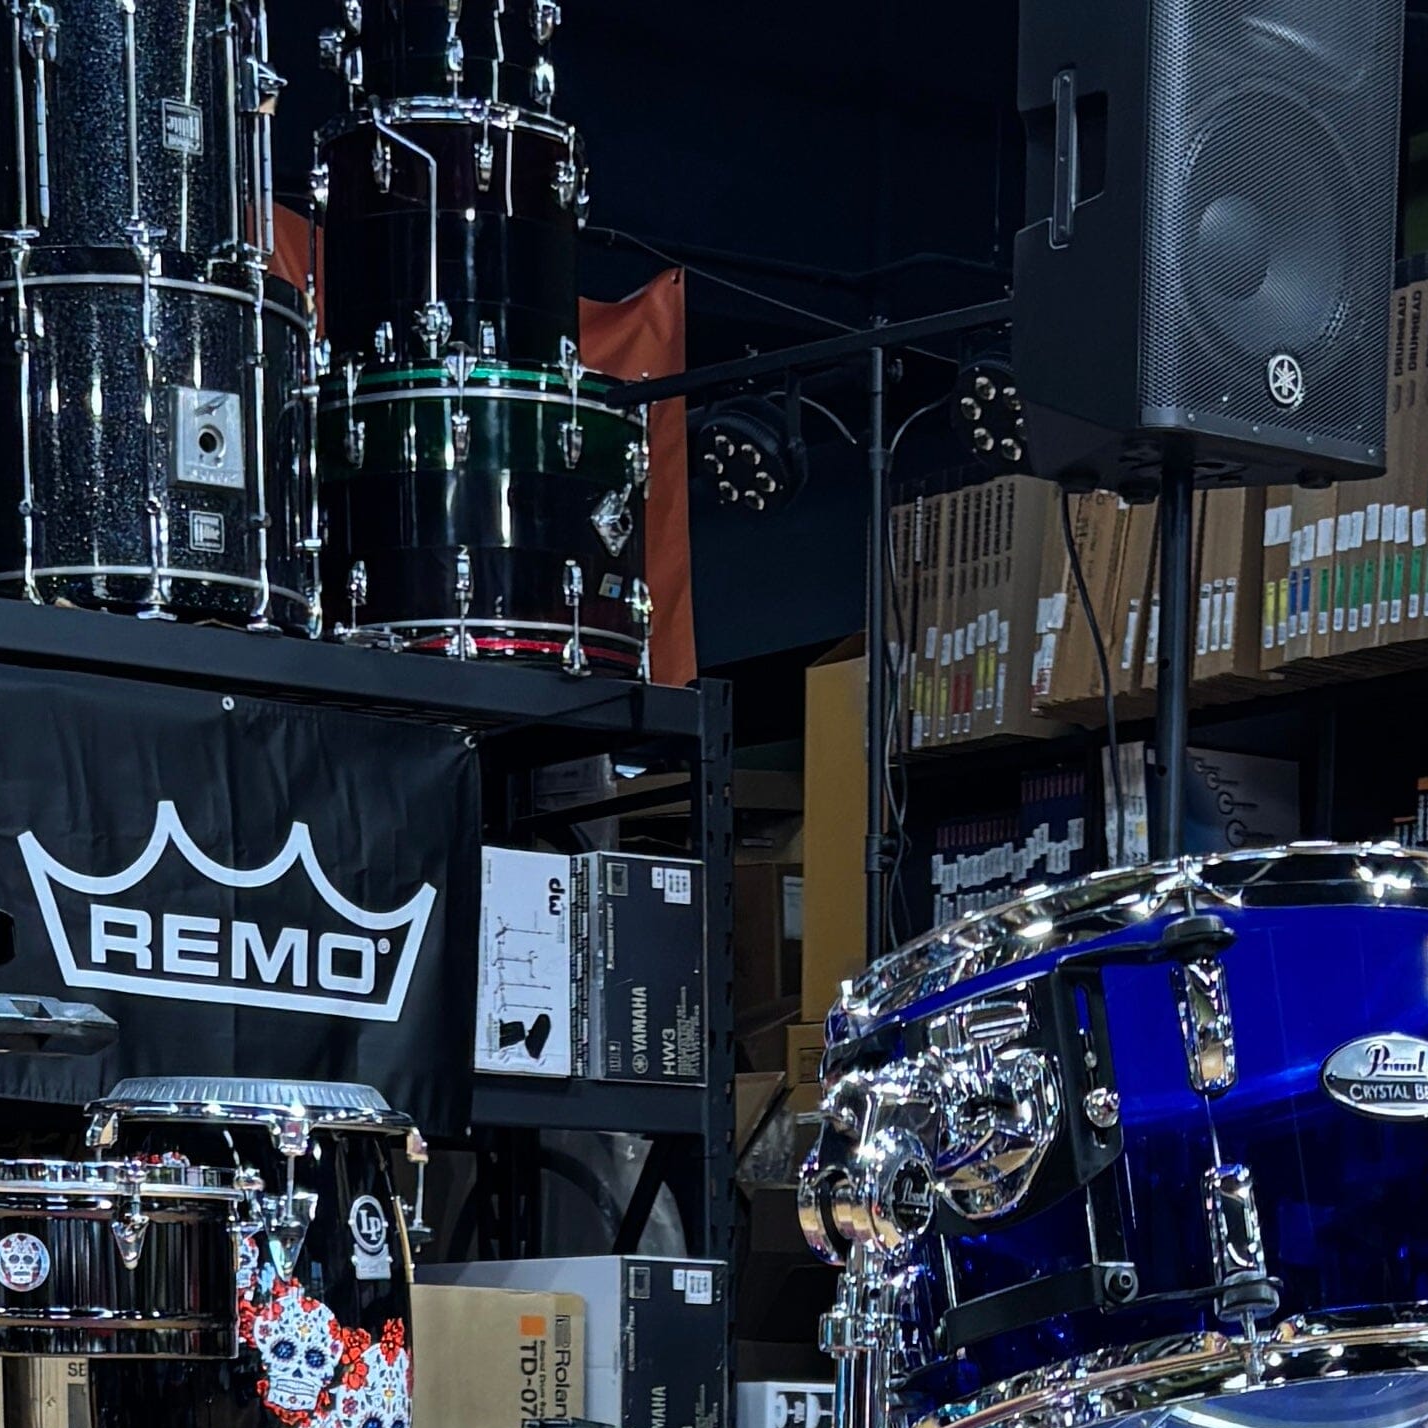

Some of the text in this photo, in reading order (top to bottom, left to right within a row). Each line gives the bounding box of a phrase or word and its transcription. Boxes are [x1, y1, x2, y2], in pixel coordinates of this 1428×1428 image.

[547, 877, 566, 916] dw
[631, 986, 648, 1053] YAMAHA
[662, 1028, 677, 1075] HW3
[359, 1209, 382, 1241] LP
[554, 1350, 571, 1419] Rolan
